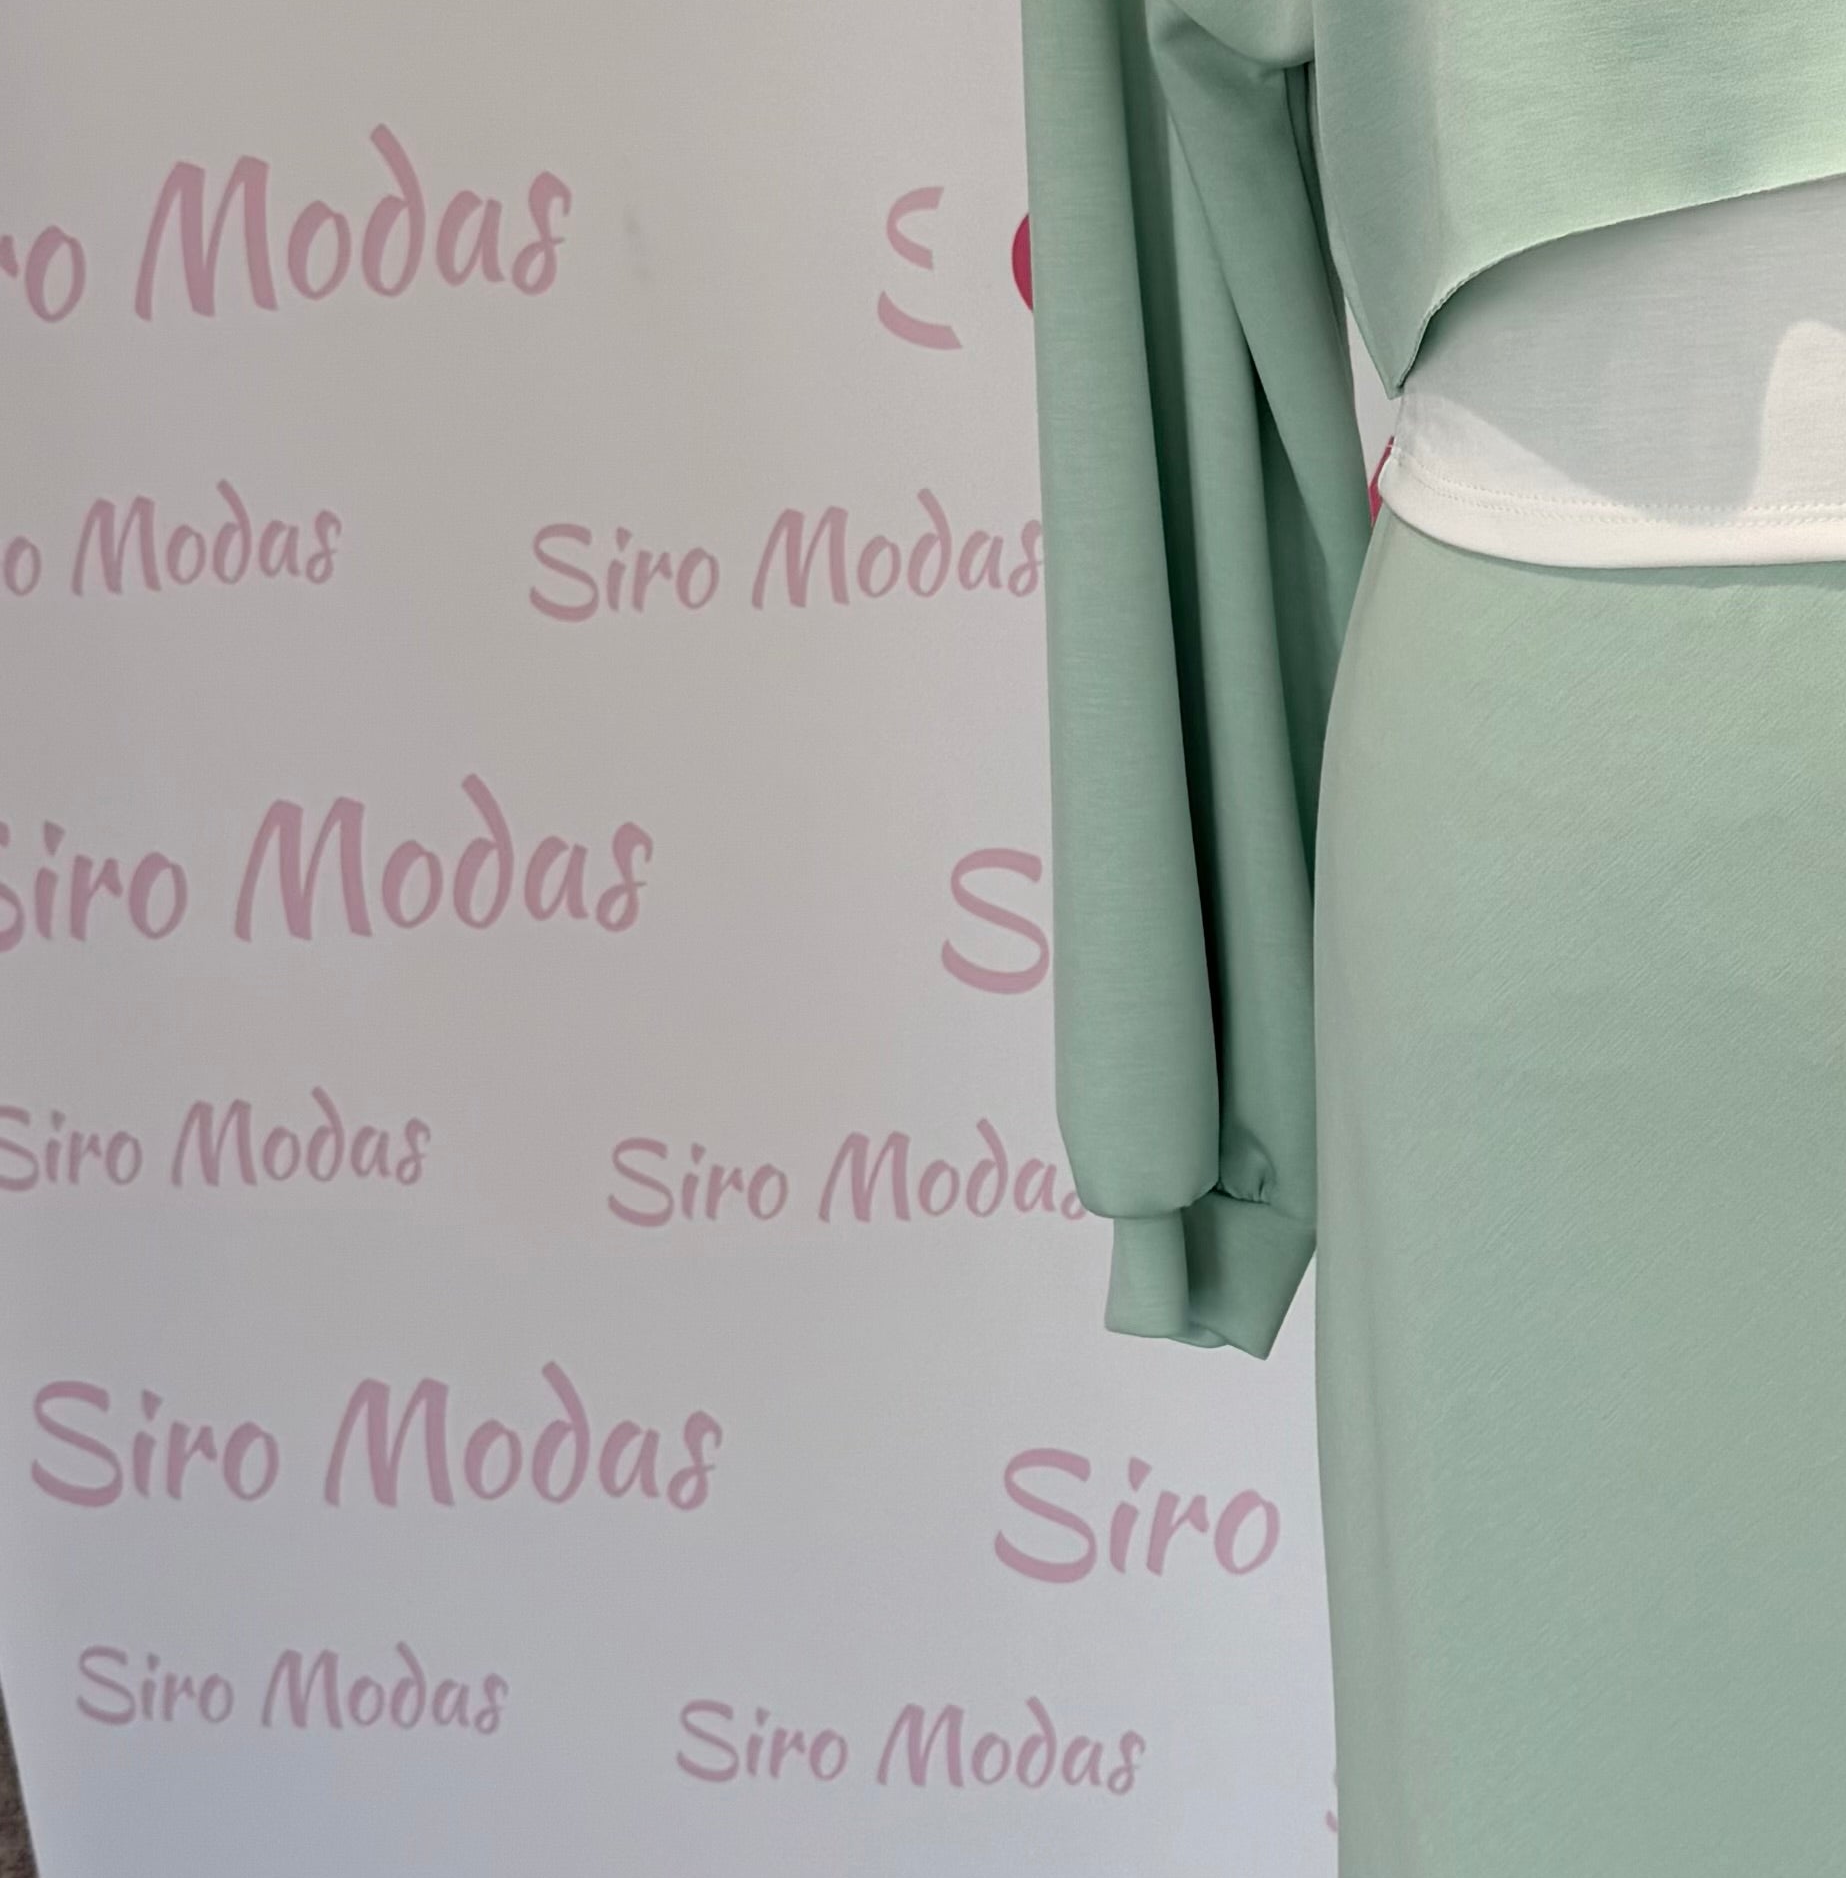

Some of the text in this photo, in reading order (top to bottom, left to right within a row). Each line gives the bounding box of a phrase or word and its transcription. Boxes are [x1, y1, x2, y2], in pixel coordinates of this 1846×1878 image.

[133, 126, 572, 322] Modas
[71, 482, 342, 594] Modas
[528, 490, 1039, 624] Siro Modas
[0, 775, 651, 954] iro Modas
[168, 1086, 428, 1187] Modas
[608, 1137, 788, 1228] Siro
[30, 1364, 719, 1511] Siro Modas
[993, 1448, 1280, 1585] Siro
[76, 1643, 509, 1734] Siro Modas
[676, 1697, 1146, 1795] Siro Modas
